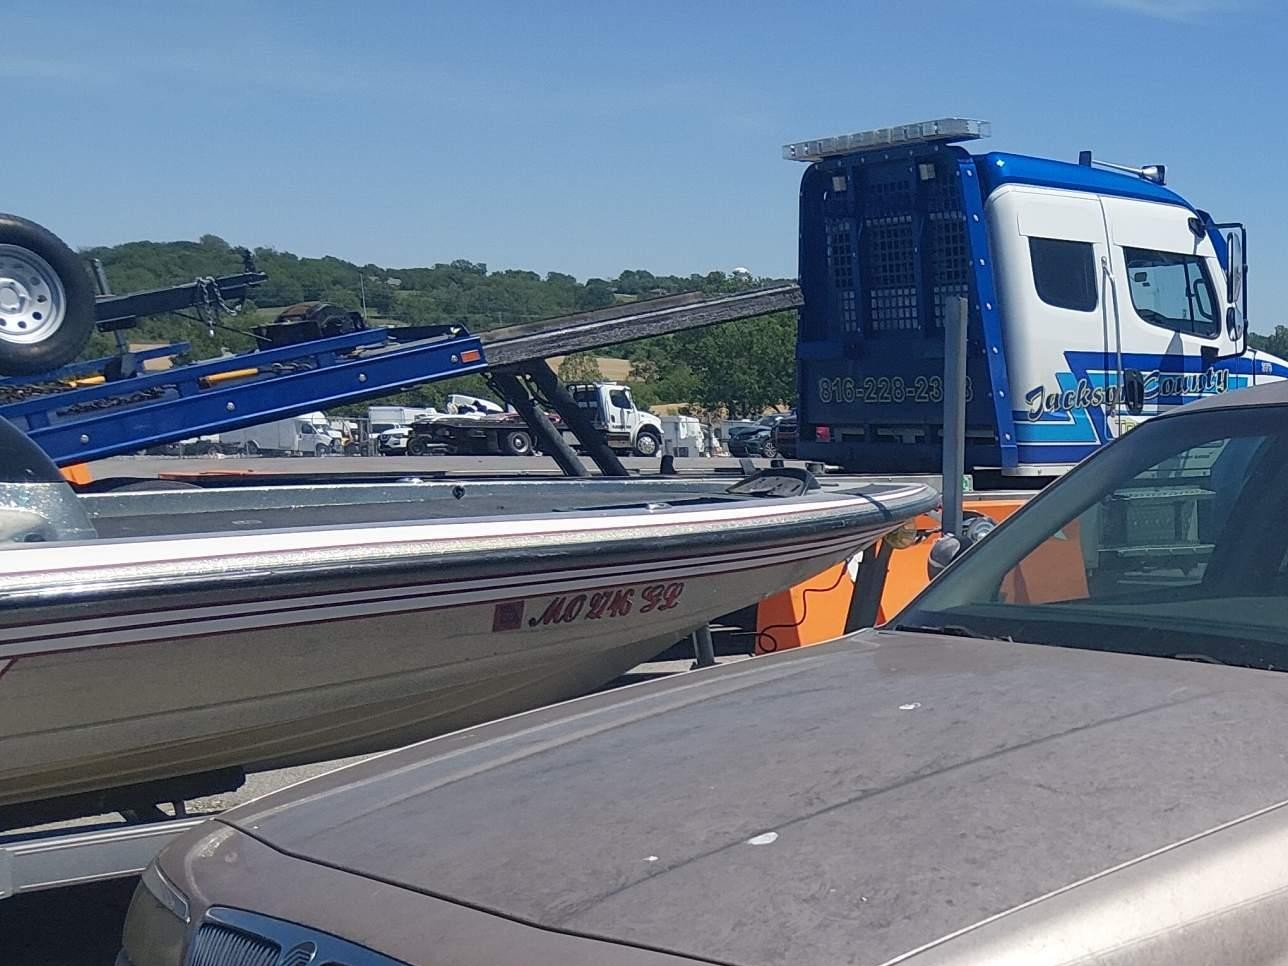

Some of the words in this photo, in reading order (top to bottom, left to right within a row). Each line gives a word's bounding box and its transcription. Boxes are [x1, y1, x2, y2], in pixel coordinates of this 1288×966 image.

[819, 375, 974, 403] 816-228-23
[1143, 366, 1229, 401] County
[528, 594, 587, 627] MO
